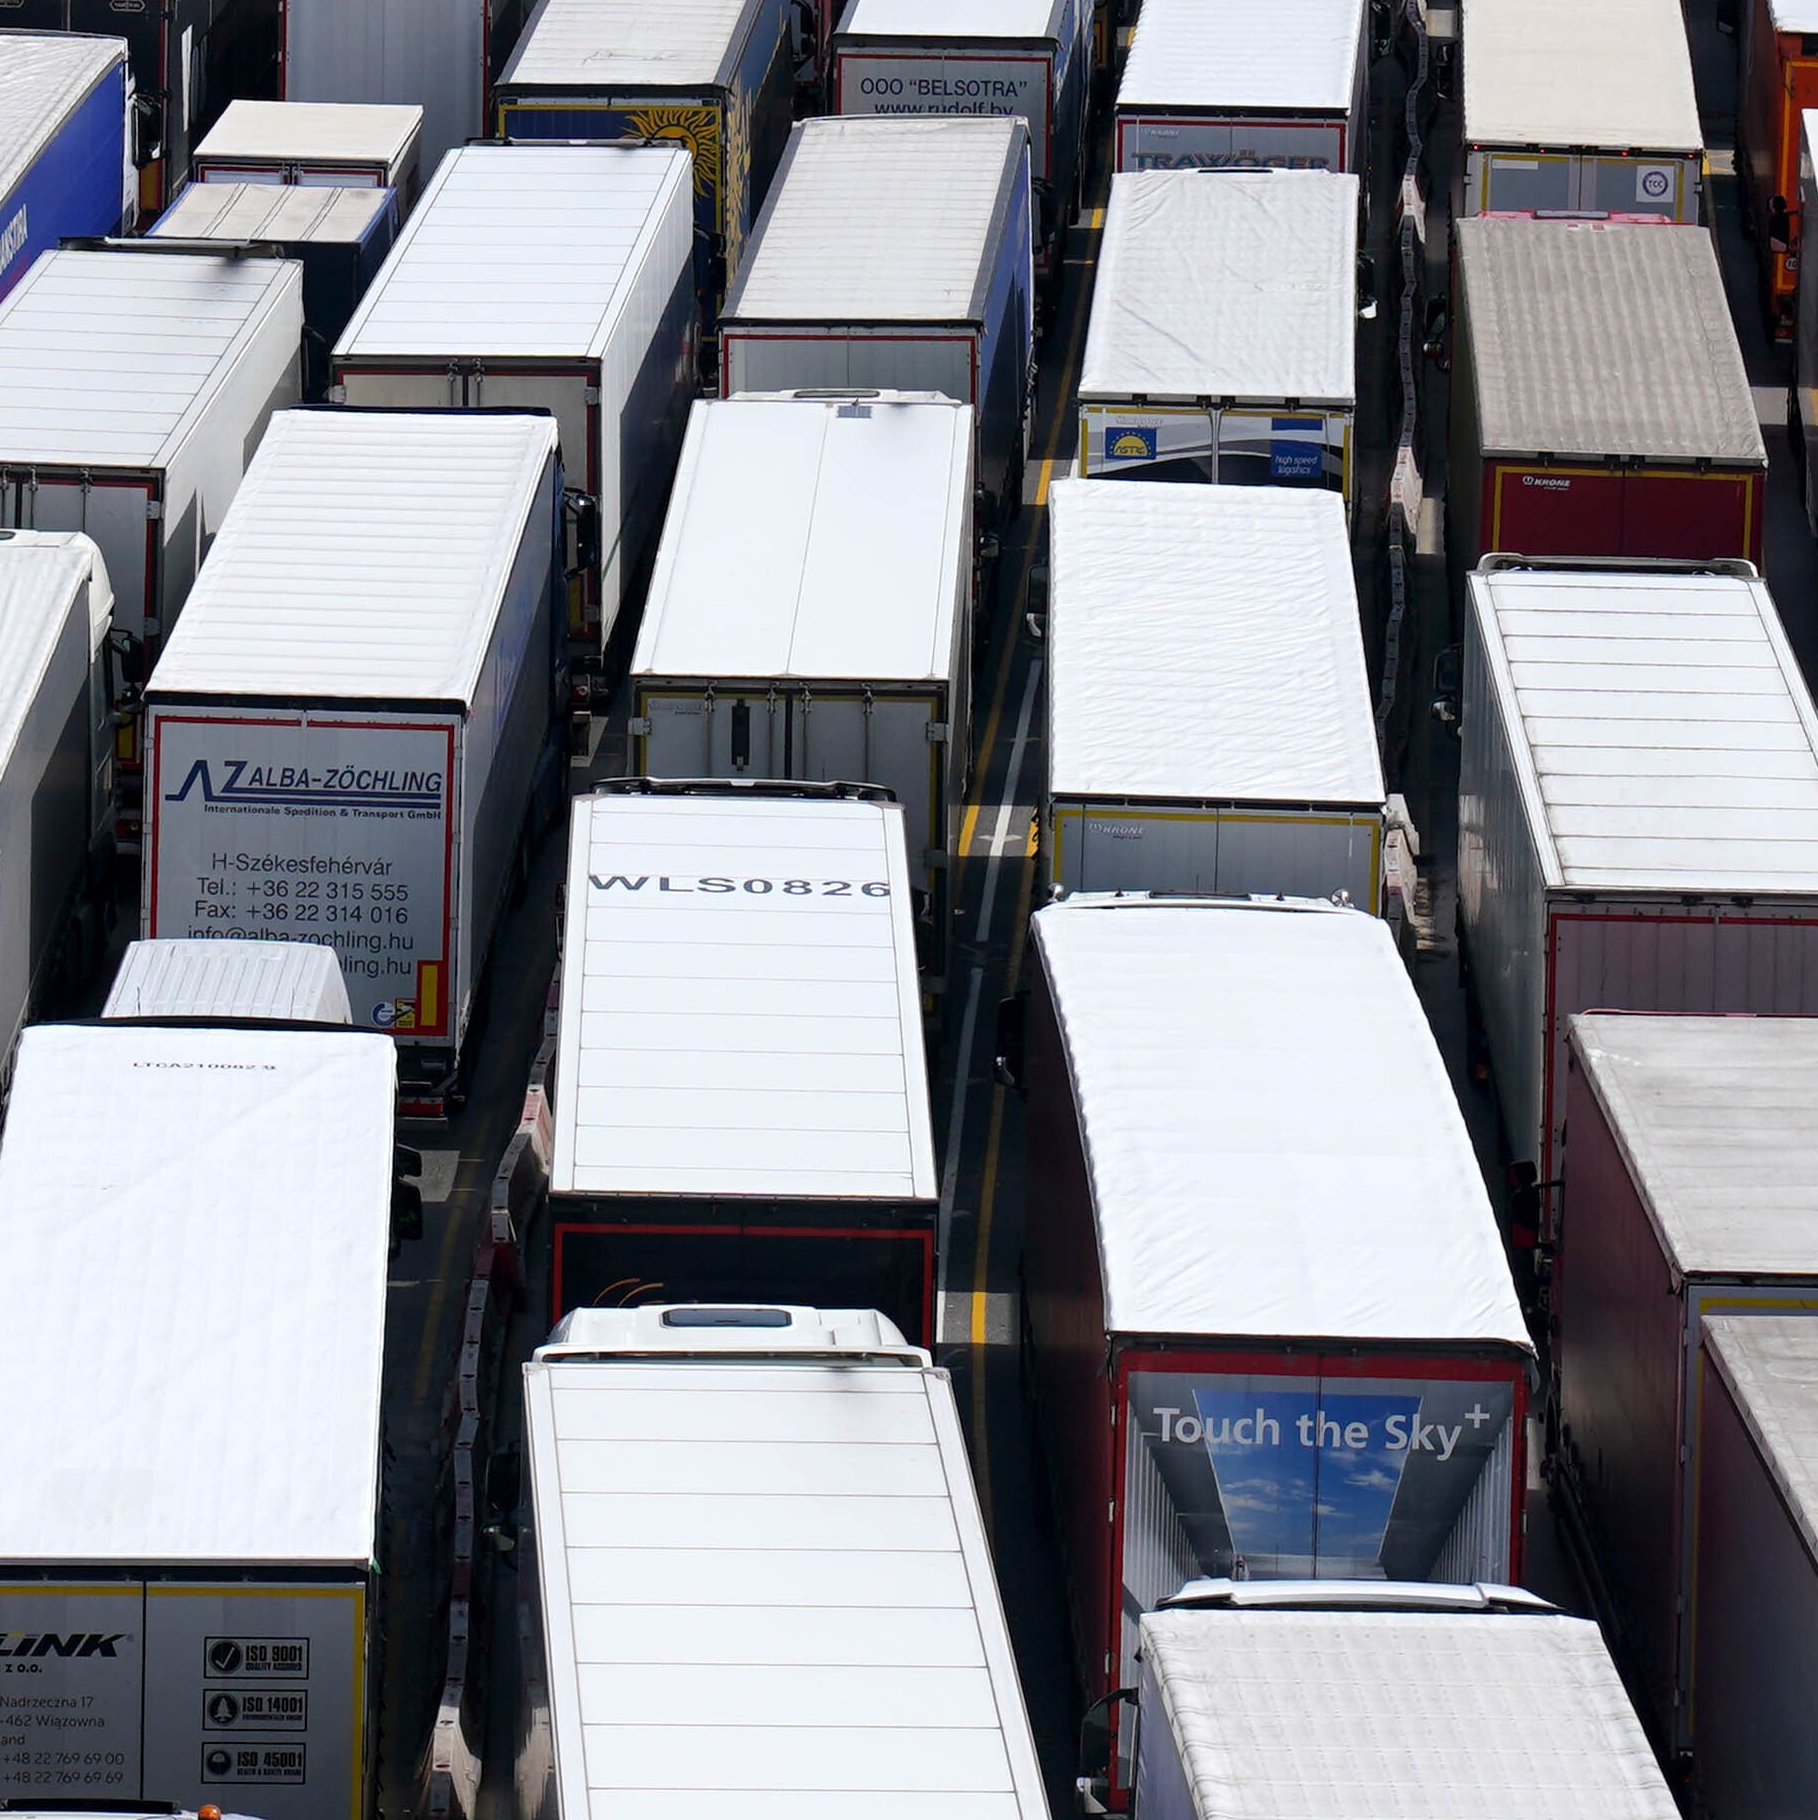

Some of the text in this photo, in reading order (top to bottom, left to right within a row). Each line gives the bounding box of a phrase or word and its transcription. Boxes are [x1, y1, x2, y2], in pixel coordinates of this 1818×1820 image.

[1275, 454, 1318, 467] high speed
[1534, 478, 1571, 487] KRONE
[248, 764, 443, 793] ALBA-ZÖCHLING
[204, 803, 442, 821] Internationale Spedition & Transport GmbH
[212, 851, 393, 875] H-Székesfehérvár
[197, 876, 409, 902] Tel.: +36 22 315 555
[588, 874, 891, 898] WLS0826
[195, 899, 409, 925] Fax: +36 22 314 016
[1153, 1406, 1280, 1447] Touch
[1296, 1409, 1369, 1449] the
[245, 1645, 303, 1662] ISO 9001
[5, 1663, 13, 1673] z
[16, 1663, 42, 1674] o.o.
[0, 1696, 77, 1708] Nadrzeczna
[81, 1696, 94, 1708] 17
[242, 1697, 303, 1713] ISO 14001
[4, 1753, 30, 1765] +48
[34, 1753, 51, 1765] 22
[57, 1753, 80, 1766] 769
[84, 1753, 101, 1766] 69
[105, 1753, 125, 1766] 00
[237, 1751, 302, 1768] ISO 45001
[4, 1772, 30, 1784] +48
[34, 1772, 51, 1784] 22
[57, 1772, 79, 1784] 769
[84, 1772, 101, 1784] 69
[105, 1772, 124, 1785] 69
